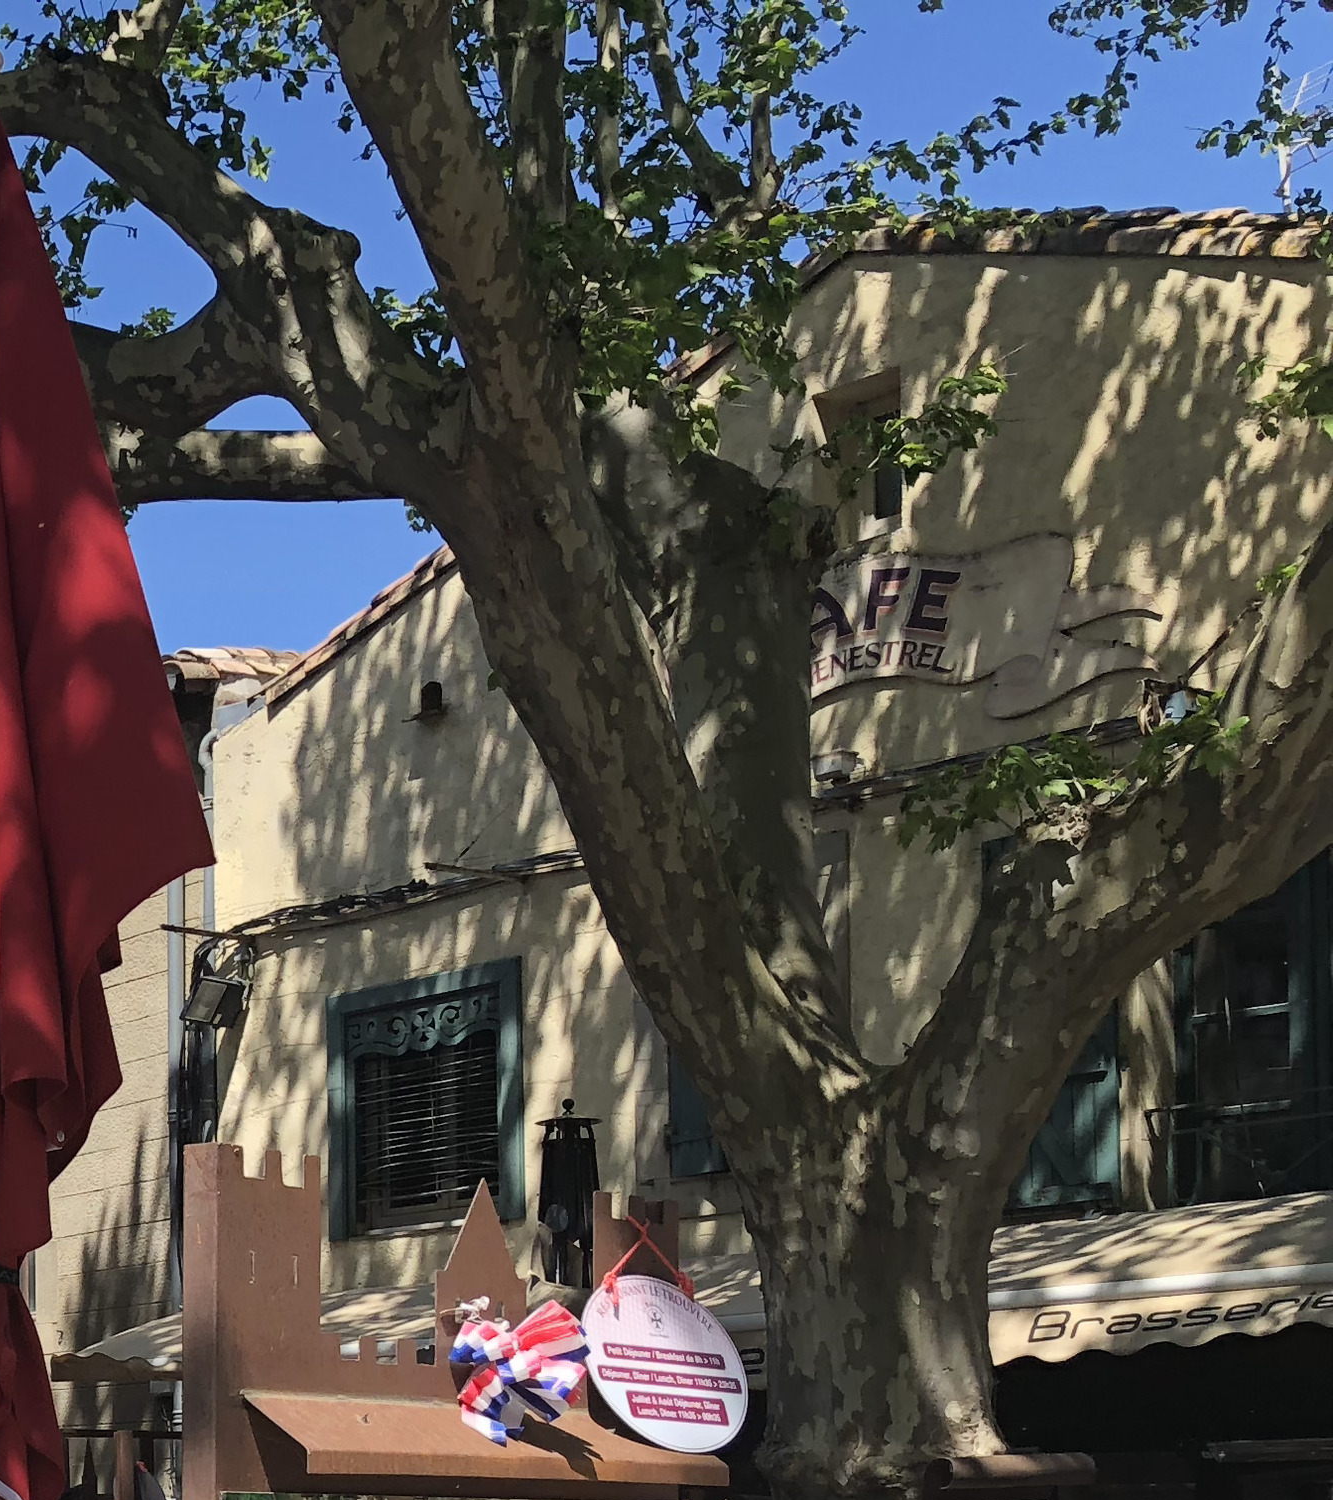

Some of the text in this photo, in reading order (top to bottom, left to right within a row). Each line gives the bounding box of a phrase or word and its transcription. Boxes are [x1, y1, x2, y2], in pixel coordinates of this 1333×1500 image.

[810, 567, 961, 640] AFE
[809, 640, 954, 685] ENESTREL
[596, 1284, 646, 1318] RESTURANT
[1028, 1290, 1333, 1343] Brasserie
